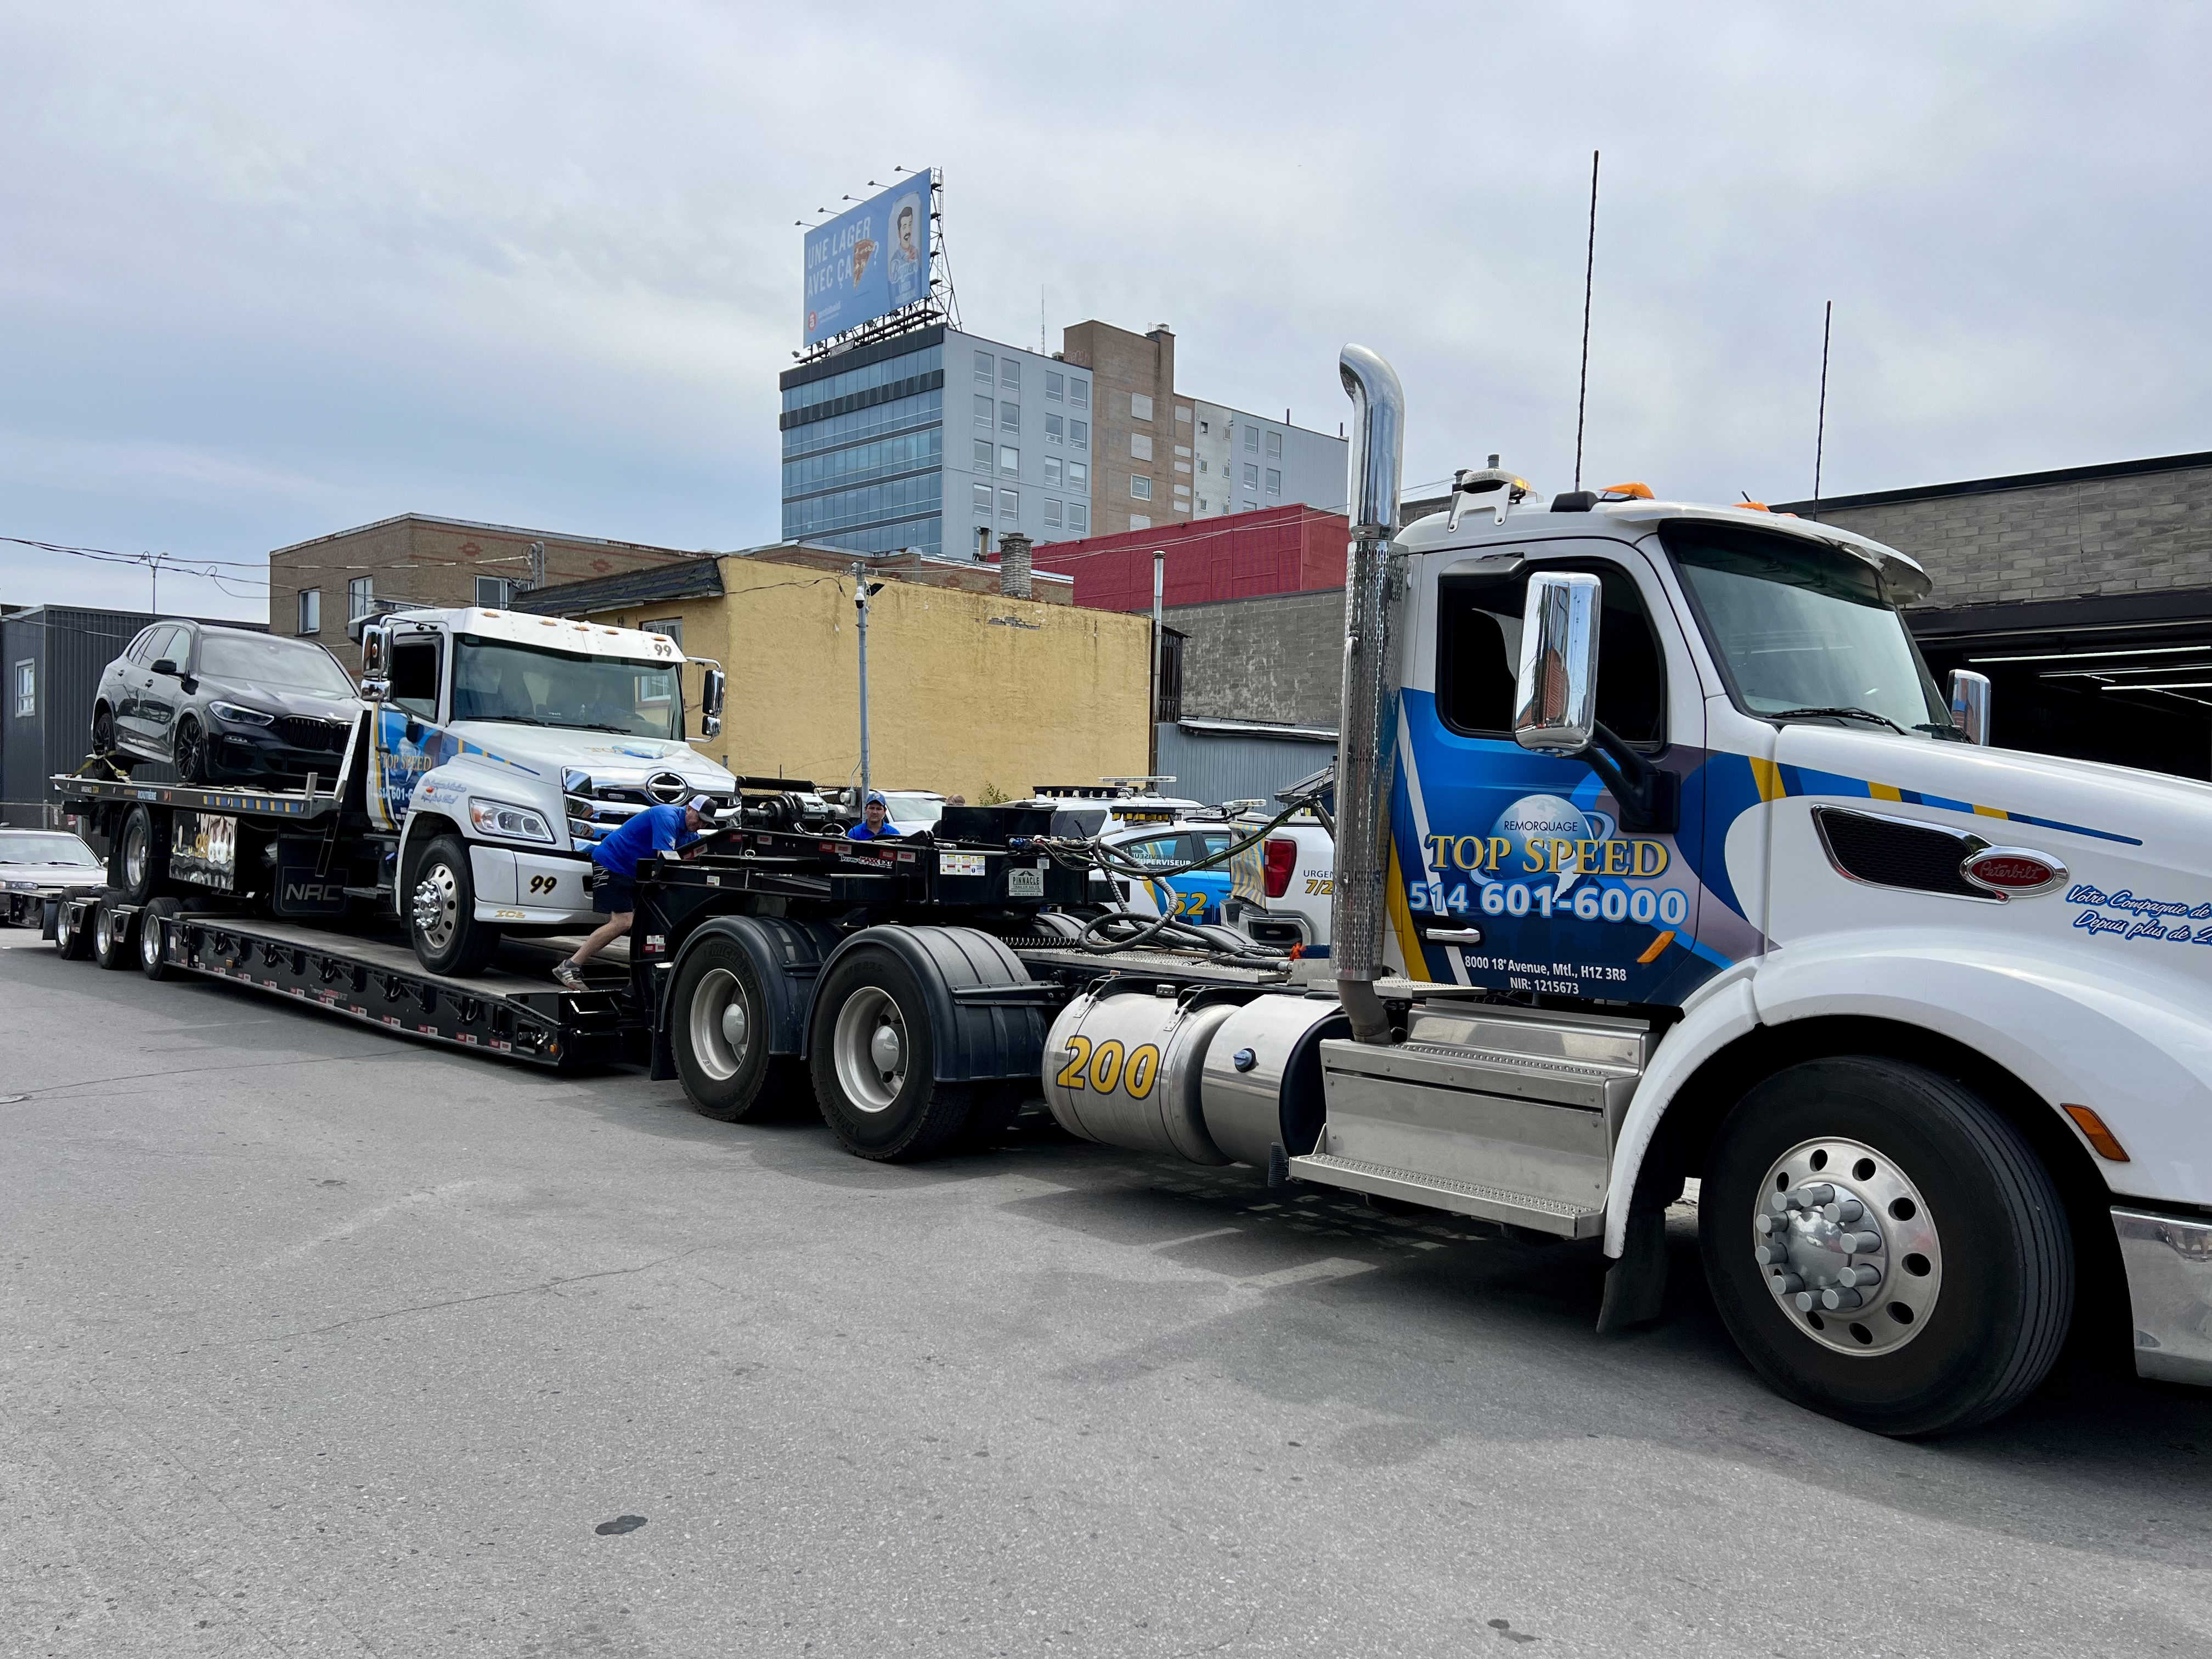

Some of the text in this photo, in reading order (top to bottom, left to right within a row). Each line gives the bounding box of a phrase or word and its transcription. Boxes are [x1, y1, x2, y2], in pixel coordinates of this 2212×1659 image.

[808, 216, 871, 269] UNE LAGER
[808, 264, 833, 298] AVEC
[837, 255, 851, 289] ÇA
[654, 644, 672, 657] 99
[381, 752, 432, 771] TOP SPEED
[391, 787, 414, 801] 601-6
[1504, 821, 1578, 832] REMORQUAGE
[1427, 834, 1668, 877] TOP SPEED
[1304, 870, 1334, 878] URGEN
[1979, 861, 2045, 879] Peterbilt
[529, 875, 557, 895] 99
[1013, 877, 1040, 885] PINNACLE
[1305, 879, 1334, 895] 7/2
[285, 884, 342, 900] NRC
[2067, 885, 2210, 918] Votre Compagnie de
[1173, 892, 1207, 916] 52
[1410, 881, 1688, 924] 514 601-6000
[494, 910, 526, 919] ICE
[2074, 911, 2212, 942] Depuis plus de 2
[1465, 956, 1488, 969] 8000
[1508, 960, 1550, 976] Avenue,
[1553, 963, 1578, 978] Mtl.,
[1581, 966, 1603, 979] H1Z
[1605, 967, 1627, 981] 3R8
[1510, 977, 1579, 994] NIR: 1215673
[1056, 1035, 1160, 1101] 200
